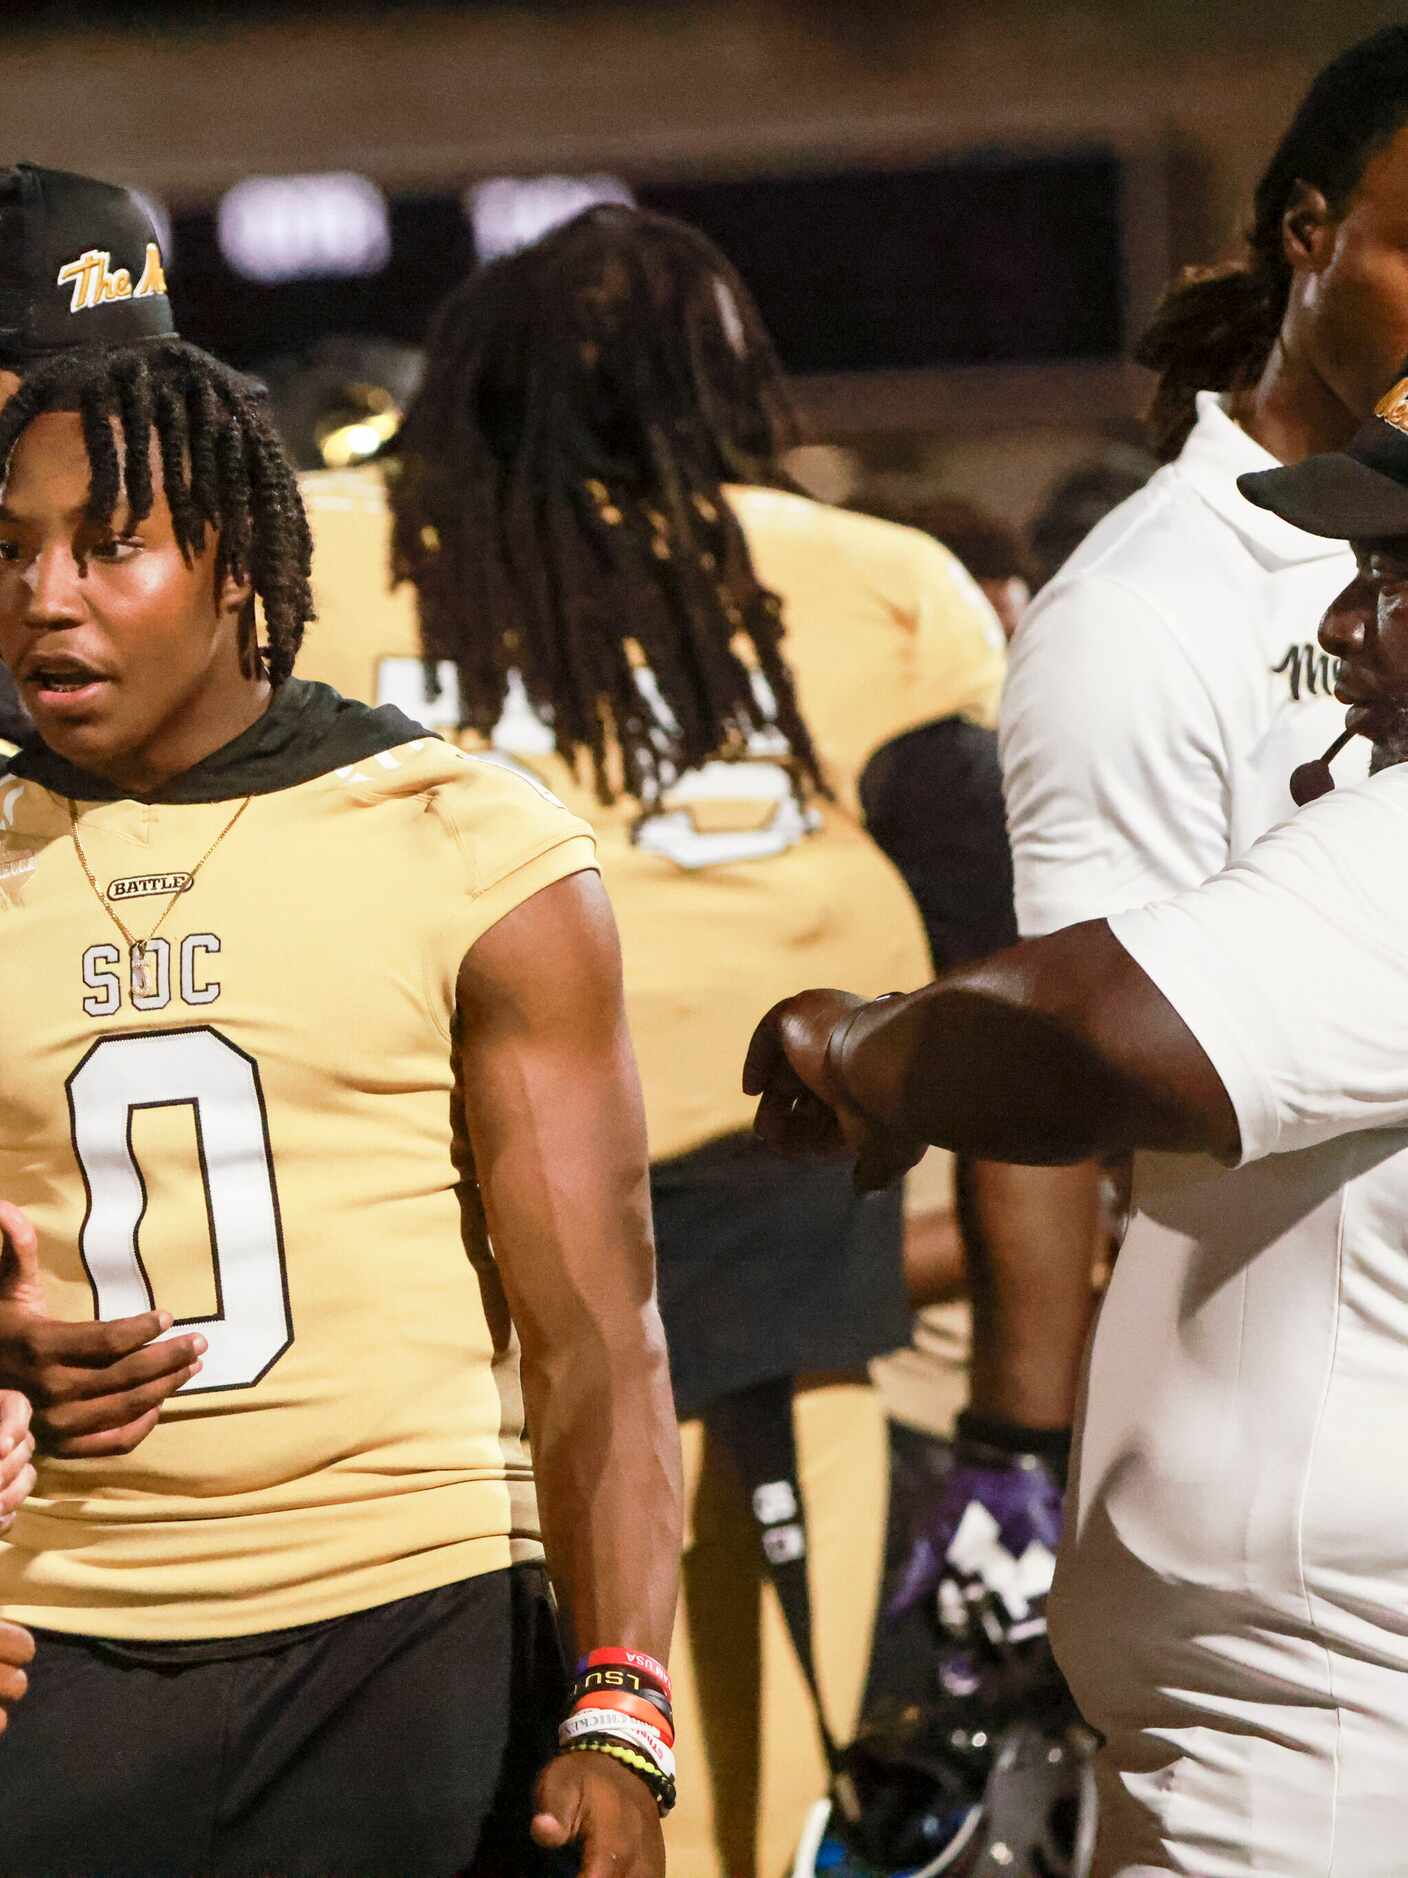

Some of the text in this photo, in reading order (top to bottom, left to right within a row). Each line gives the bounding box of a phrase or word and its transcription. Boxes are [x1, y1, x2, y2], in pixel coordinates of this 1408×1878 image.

[57, 249, 133, 314] The
[113, 876, 186, 896] BATTLE
[81, 932, 221, 1018] SOC
[64, 1024, 295, 1400] 0
[585, 1670, 640, 1690] LSU
